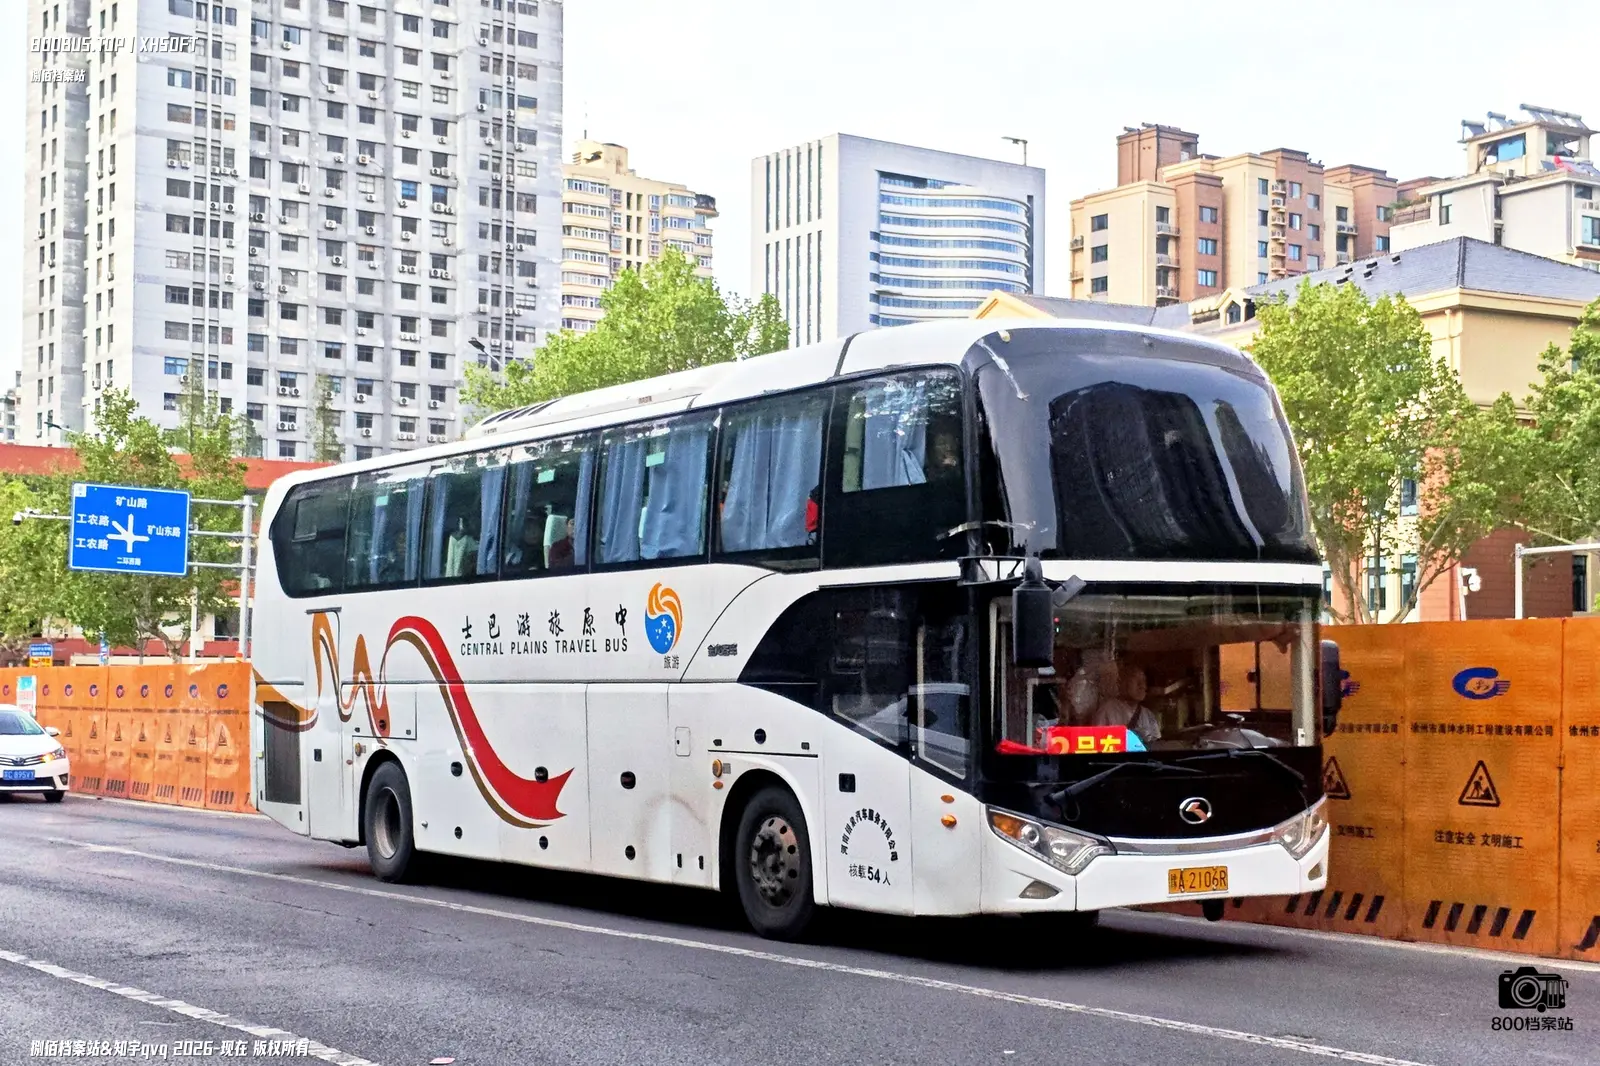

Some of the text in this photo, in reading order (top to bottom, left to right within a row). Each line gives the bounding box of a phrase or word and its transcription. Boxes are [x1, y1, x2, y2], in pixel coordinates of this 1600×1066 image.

[115, 496, 147, 509] 矿山路
[76, 513, 110, 527] 工农路
[147, 525, 181, 537] 矿山东路
[75, 538, 109, 551] 工农路
[460, 638, 628, 656] CENTRAL PLAINS TRAVEL BUS
[663, 655, 680, 669] 旅游
[1434, 830, 1524, 849] 注意安全 文明施工
